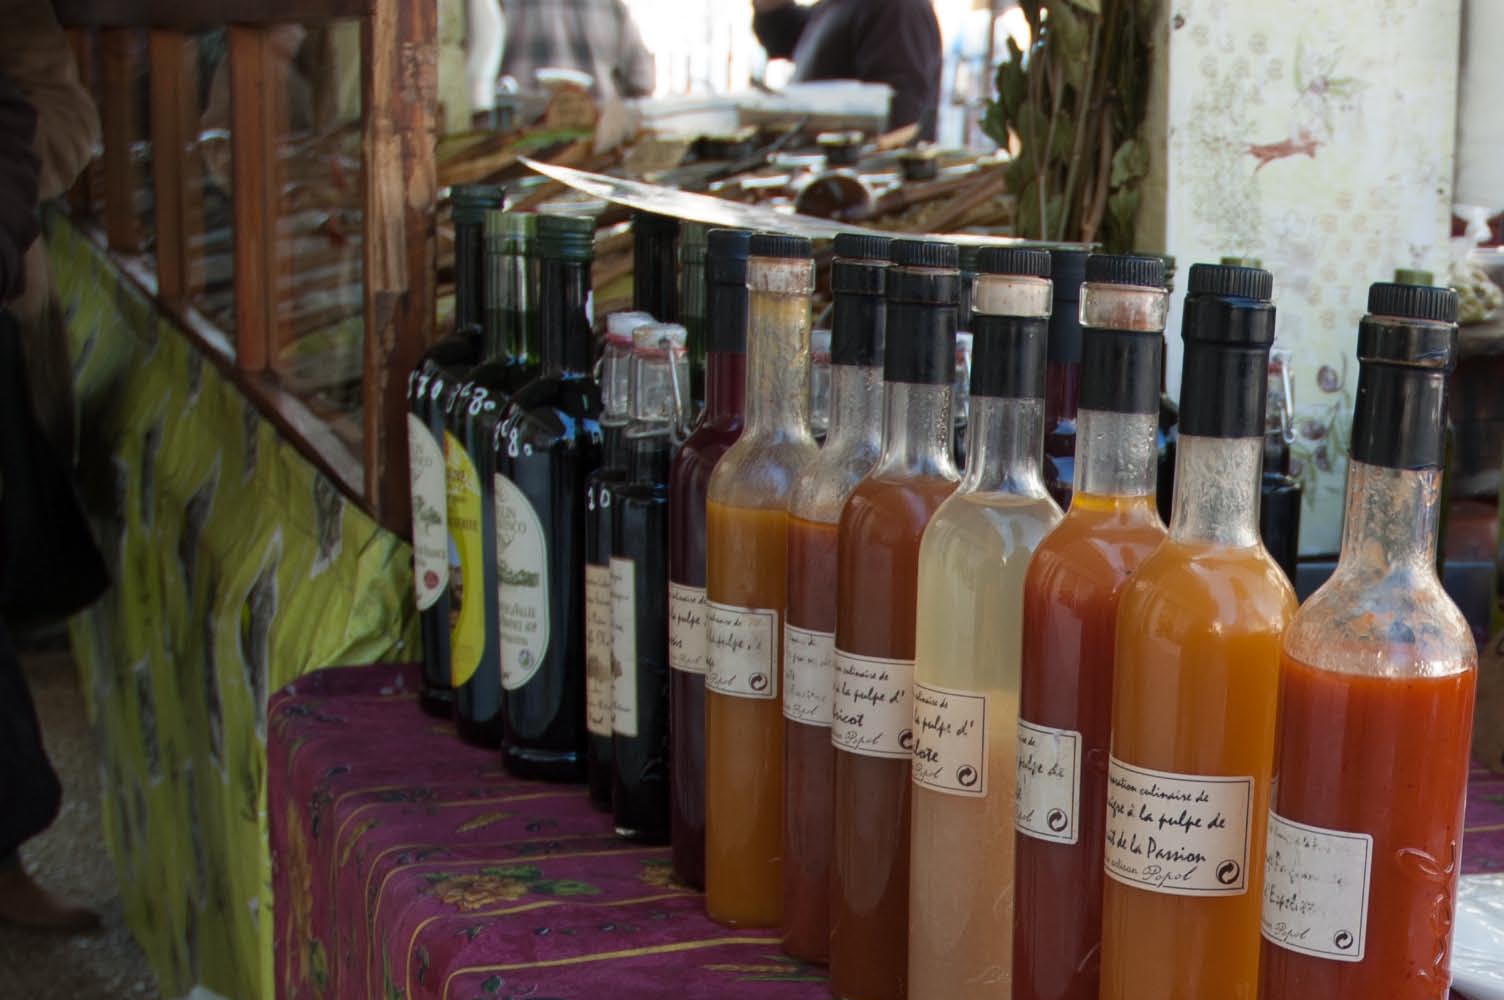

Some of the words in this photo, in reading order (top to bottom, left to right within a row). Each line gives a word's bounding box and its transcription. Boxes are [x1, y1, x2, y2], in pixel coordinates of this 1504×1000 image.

[853, 686, 885, 707] pulpe
[1139, 784, 1192, 802] culinaire
[1195, 790, 1209, 803] de
[1139, 804, 1154, 823] la
[1158, 810, 1202, 834] pulpe
[1207, 808, 1226, 829] de
[1117, 830, 1128, 849] de
[1130, 833, 1142, 855] la
[1147, 836, 1207, 864] Passion
[1142, 864, 1197, 888] Popol
